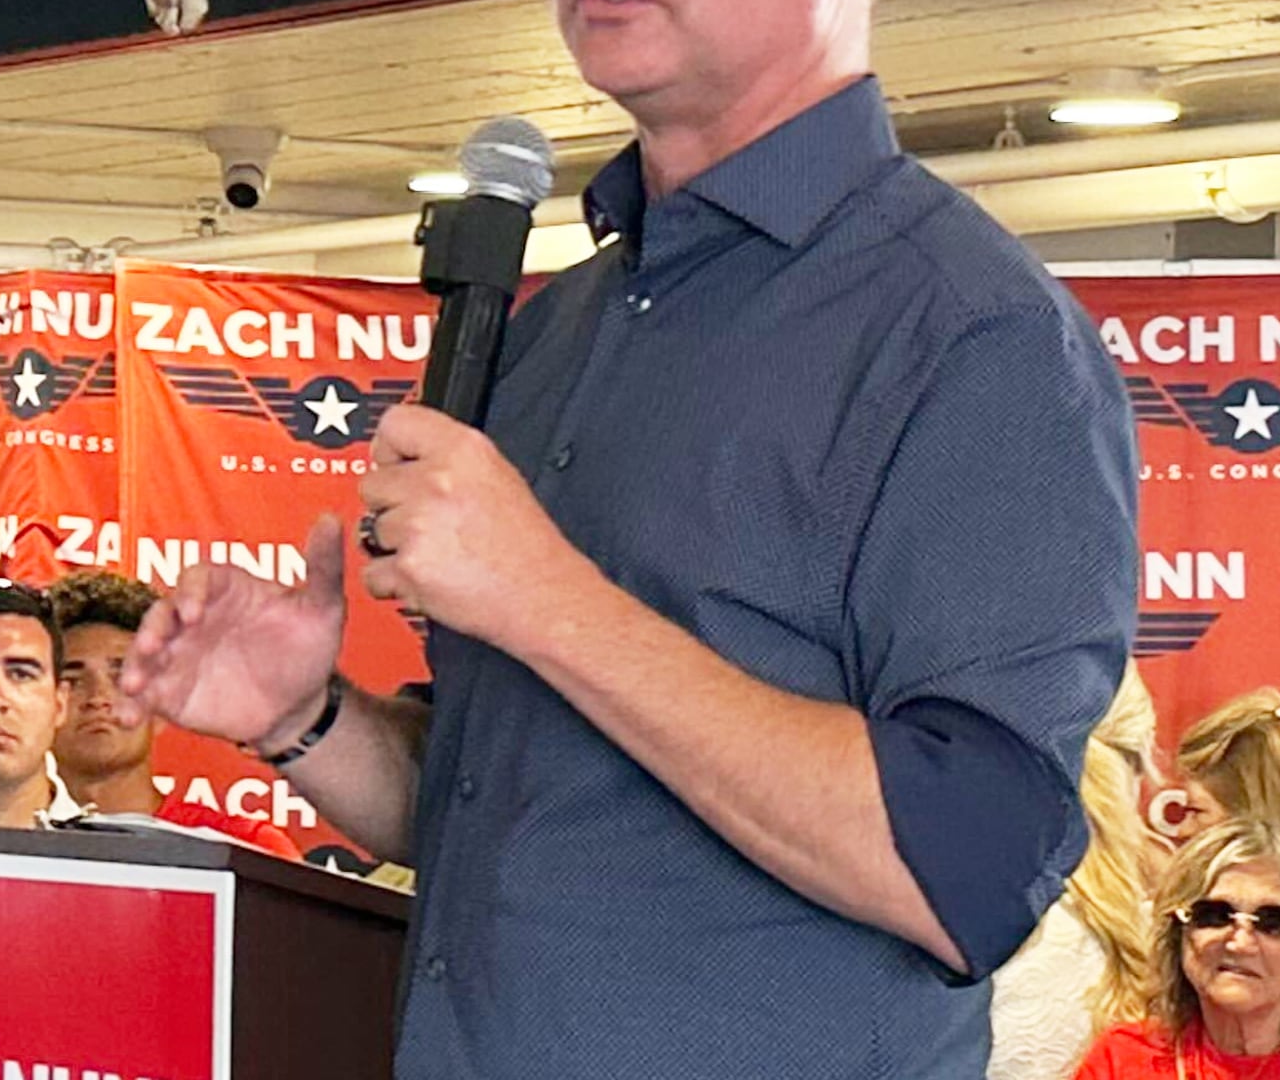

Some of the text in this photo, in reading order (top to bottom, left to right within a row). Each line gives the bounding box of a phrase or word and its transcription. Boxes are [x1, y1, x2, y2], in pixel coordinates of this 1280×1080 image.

[131, 302, 438, 362] ZACH NU
[220, 455, 378, 474] U.S. CONG
